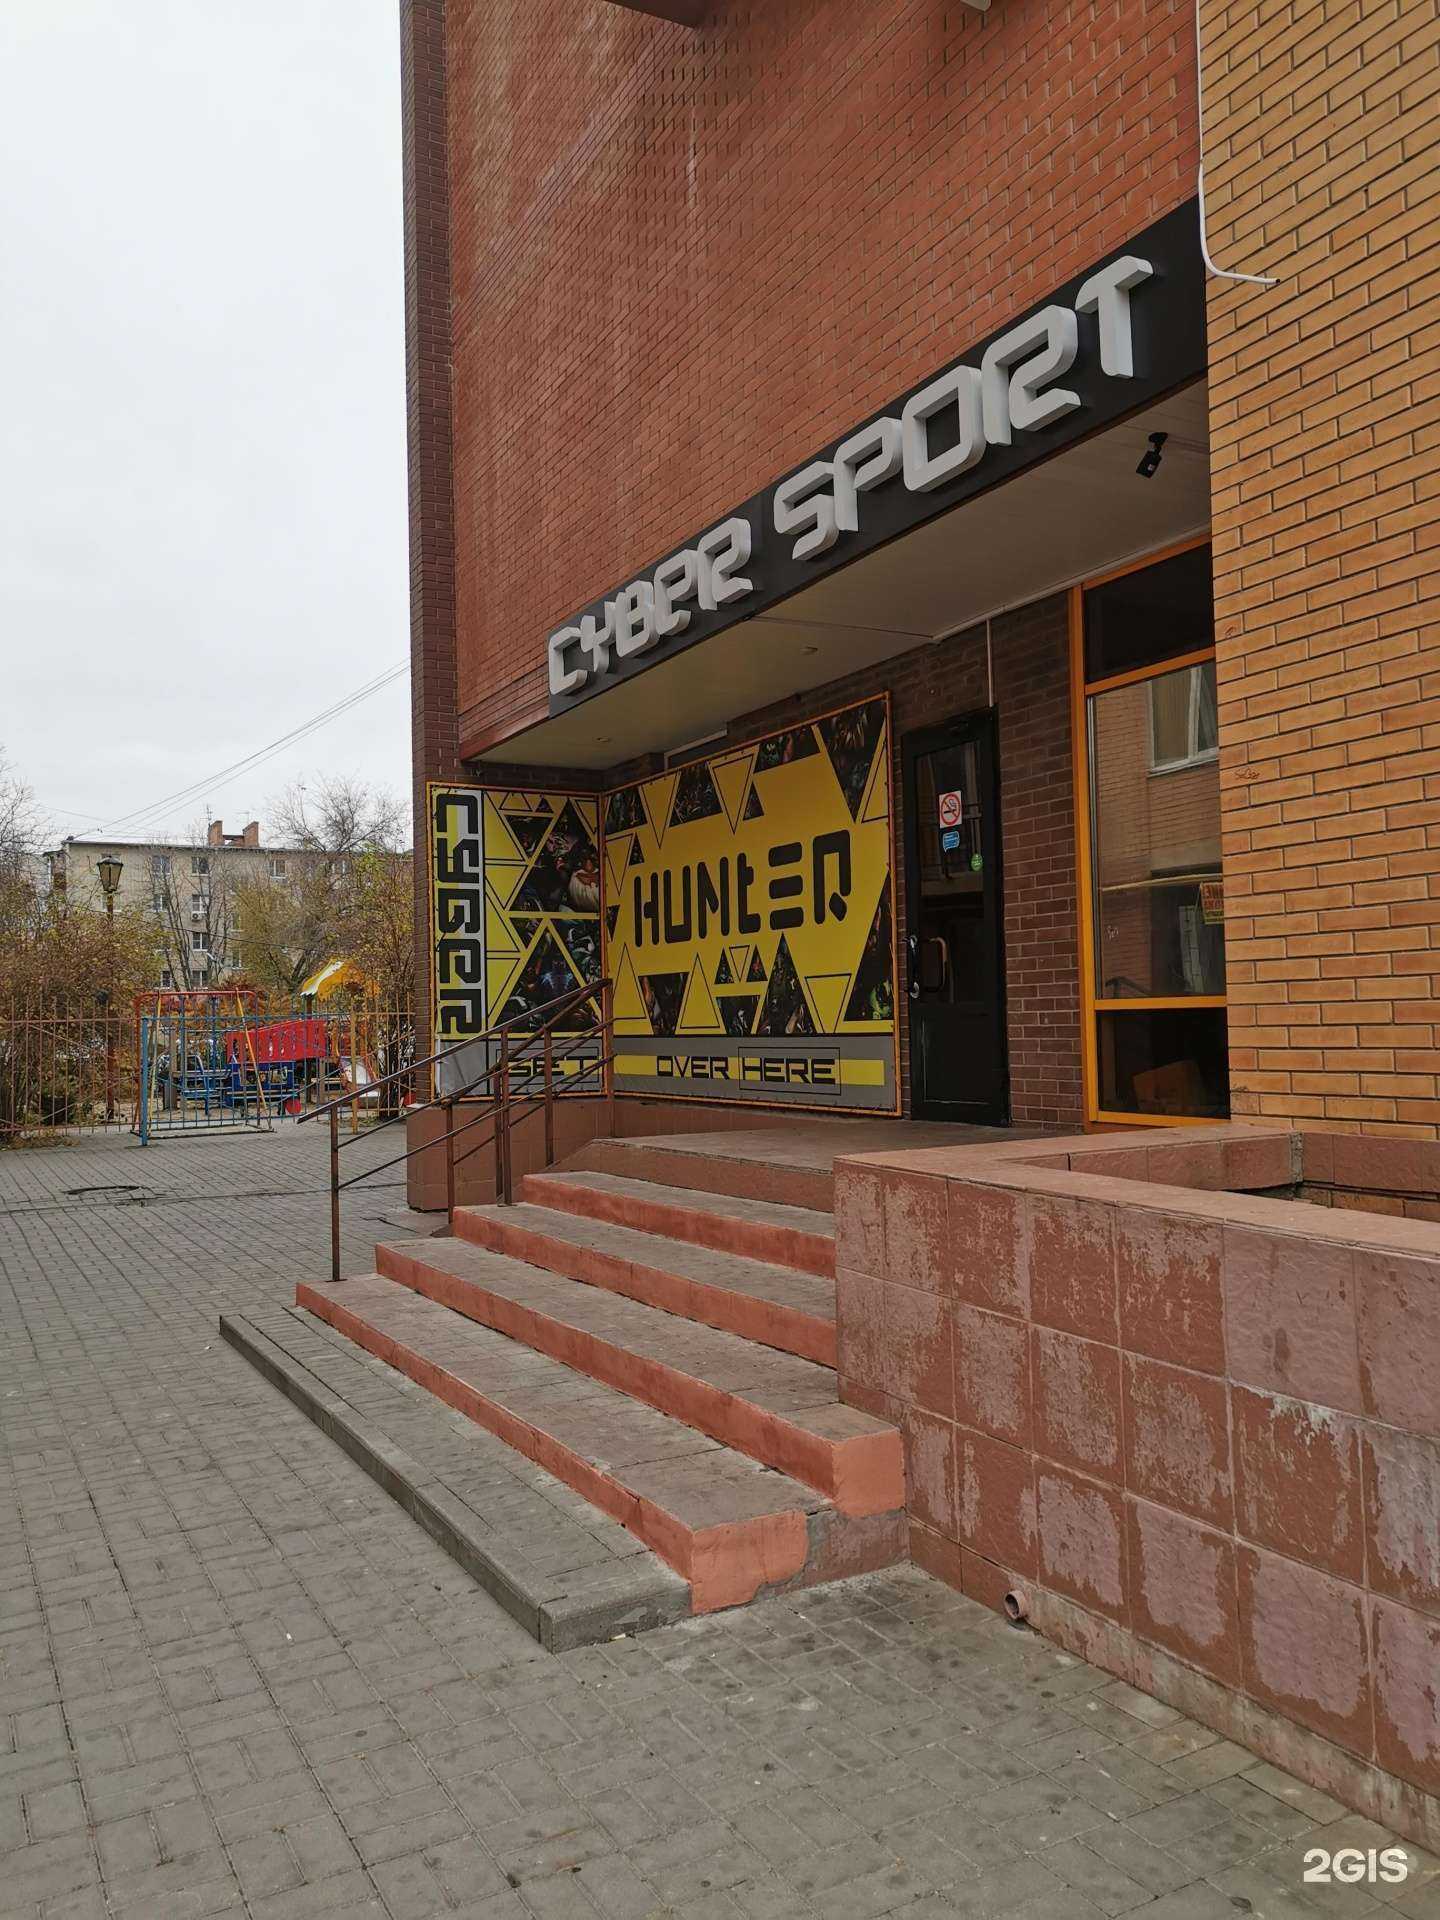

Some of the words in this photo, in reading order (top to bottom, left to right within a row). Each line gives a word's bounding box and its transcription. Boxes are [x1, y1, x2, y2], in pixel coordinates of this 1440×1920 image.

[548, 517, 753, 696] CYBER
[773, 255, 1154, 560] SPORT
[436, 793, 482, 1034] CYBER
[656, 1055, 730, 1080] OVER
[742, 1056, 836, 1085] HERE
